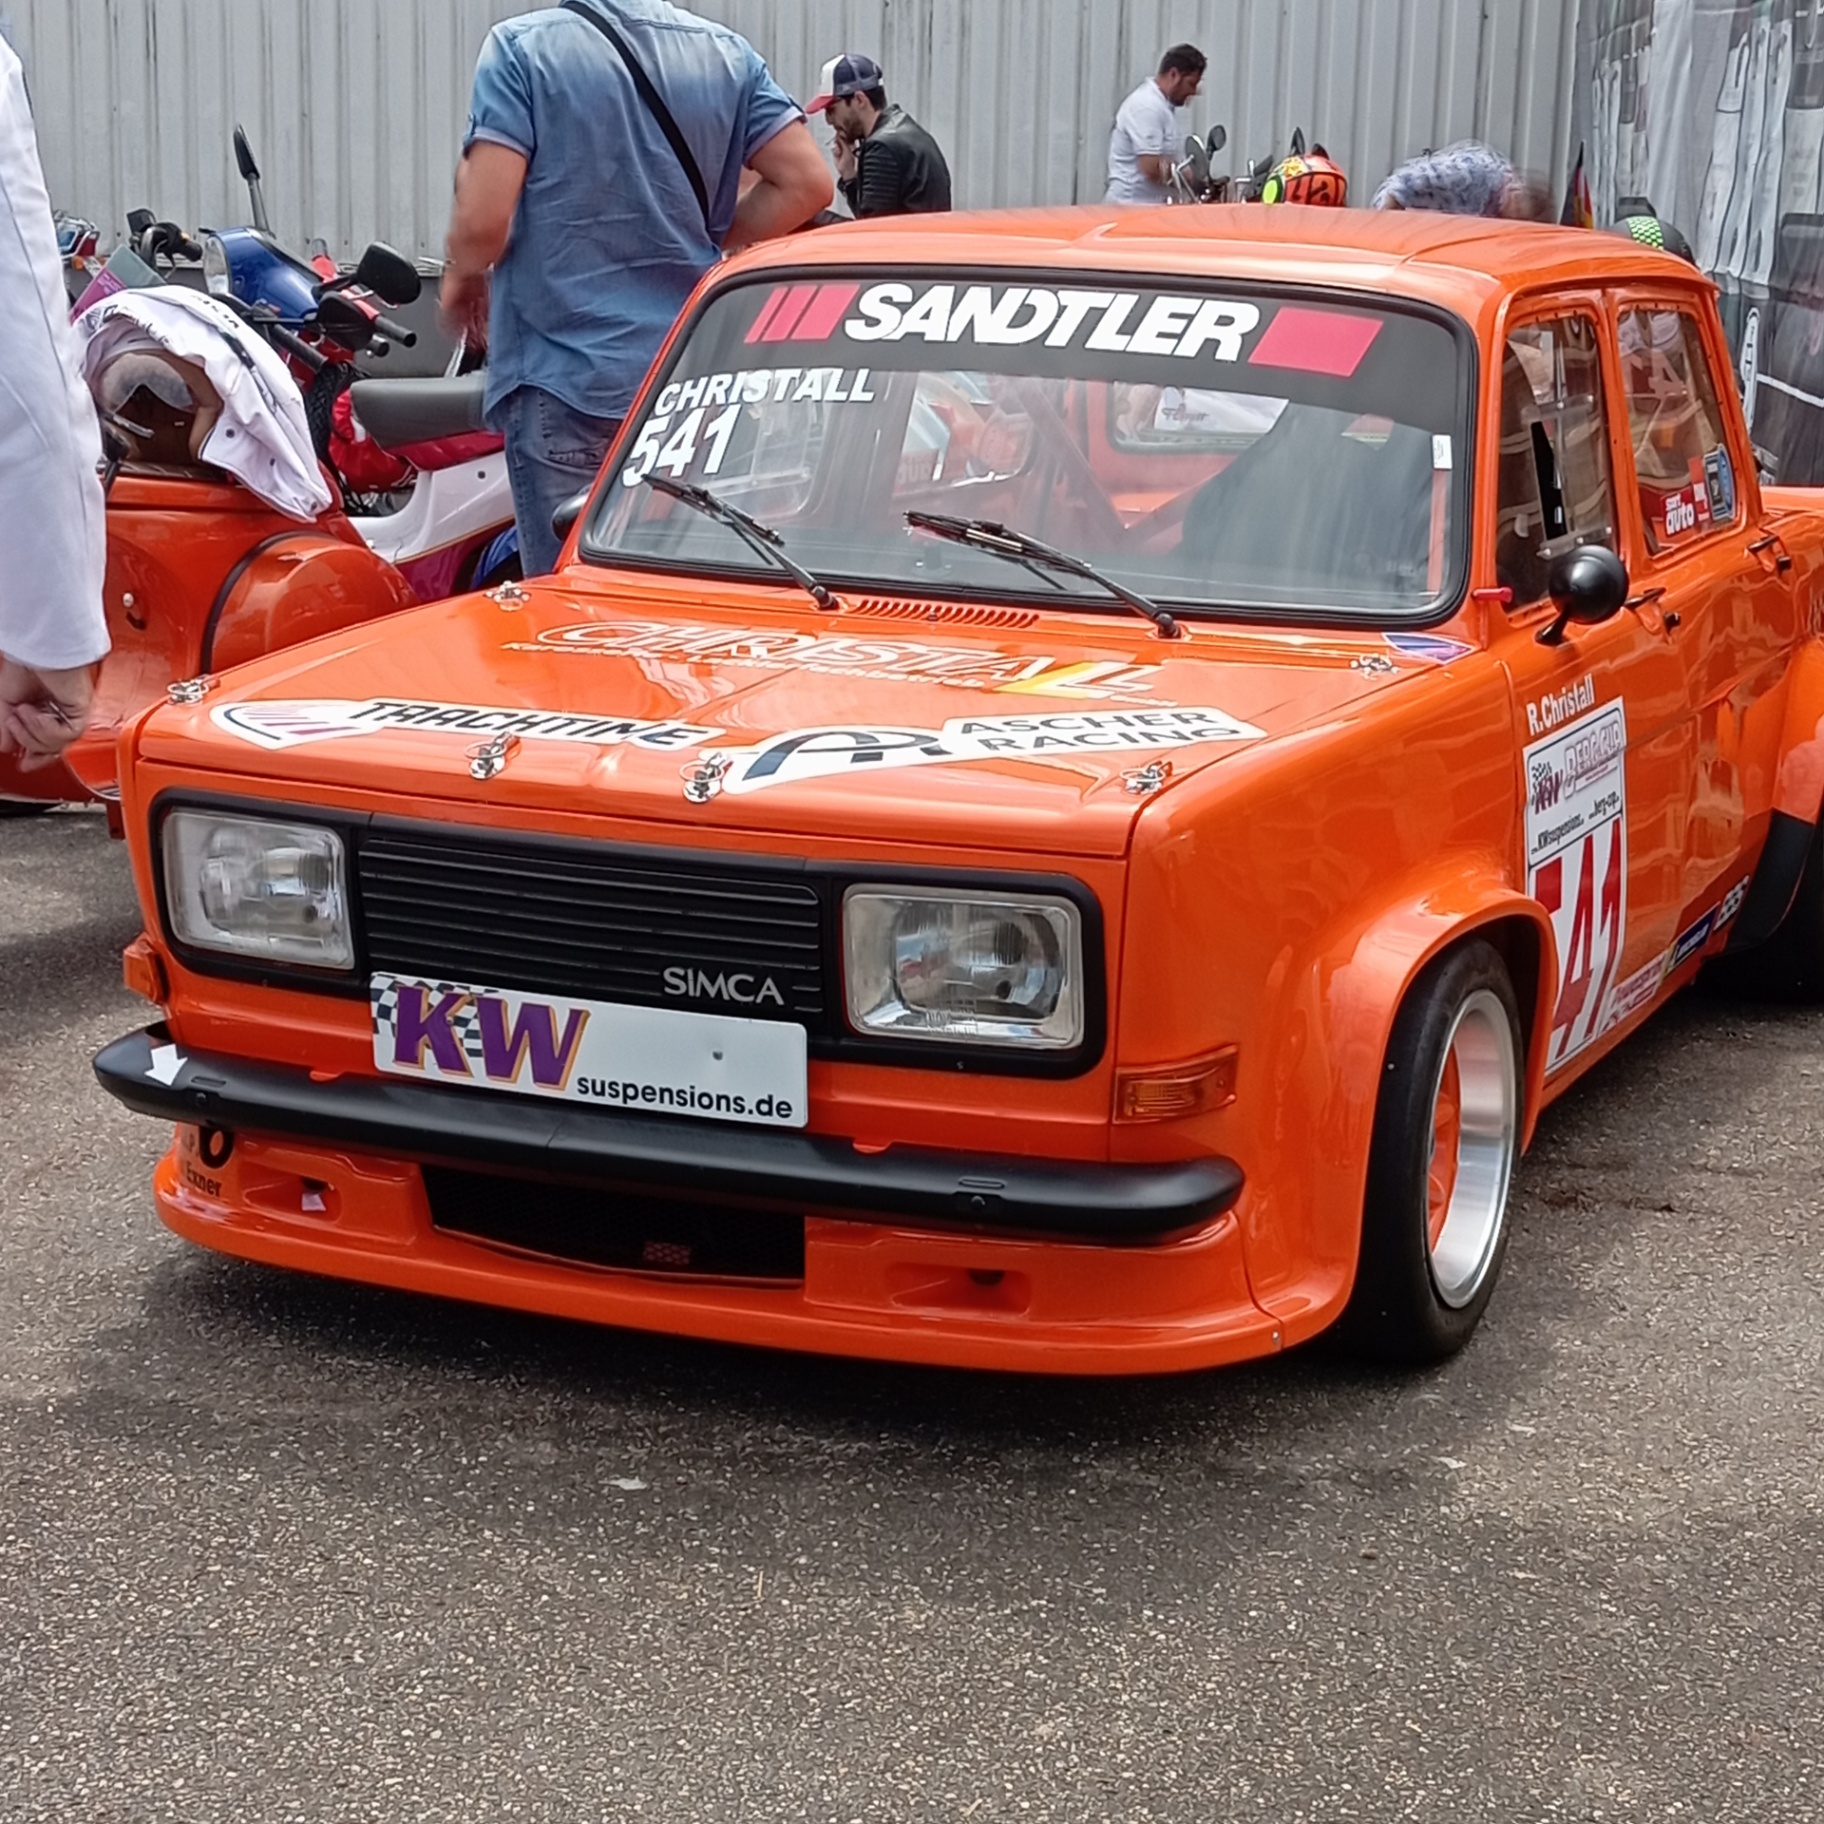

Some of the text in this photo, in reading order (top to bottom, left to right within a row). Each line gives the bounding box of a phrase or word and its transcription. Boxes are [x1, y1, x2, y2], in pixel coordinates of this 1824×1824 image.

[844, 283, 1260, 362] SANDTLER
[654, 368, 875, 417] CHRISTALL
[622, 405, 741, 488] 541
[1665, 503, 1694, 535] auto
[961, 711, 1220, 735] ASCHER
[1526, 673, 1595, 736] R.Christall
[983, 728, 1241, 752] RACING
[663, 966, 785, 1007] SIMCA
[393, 983, 592, 1091] KW
[577, 1075, 794, 1119] suspensions.de
[186, 1161, 223, 1197] Exner
